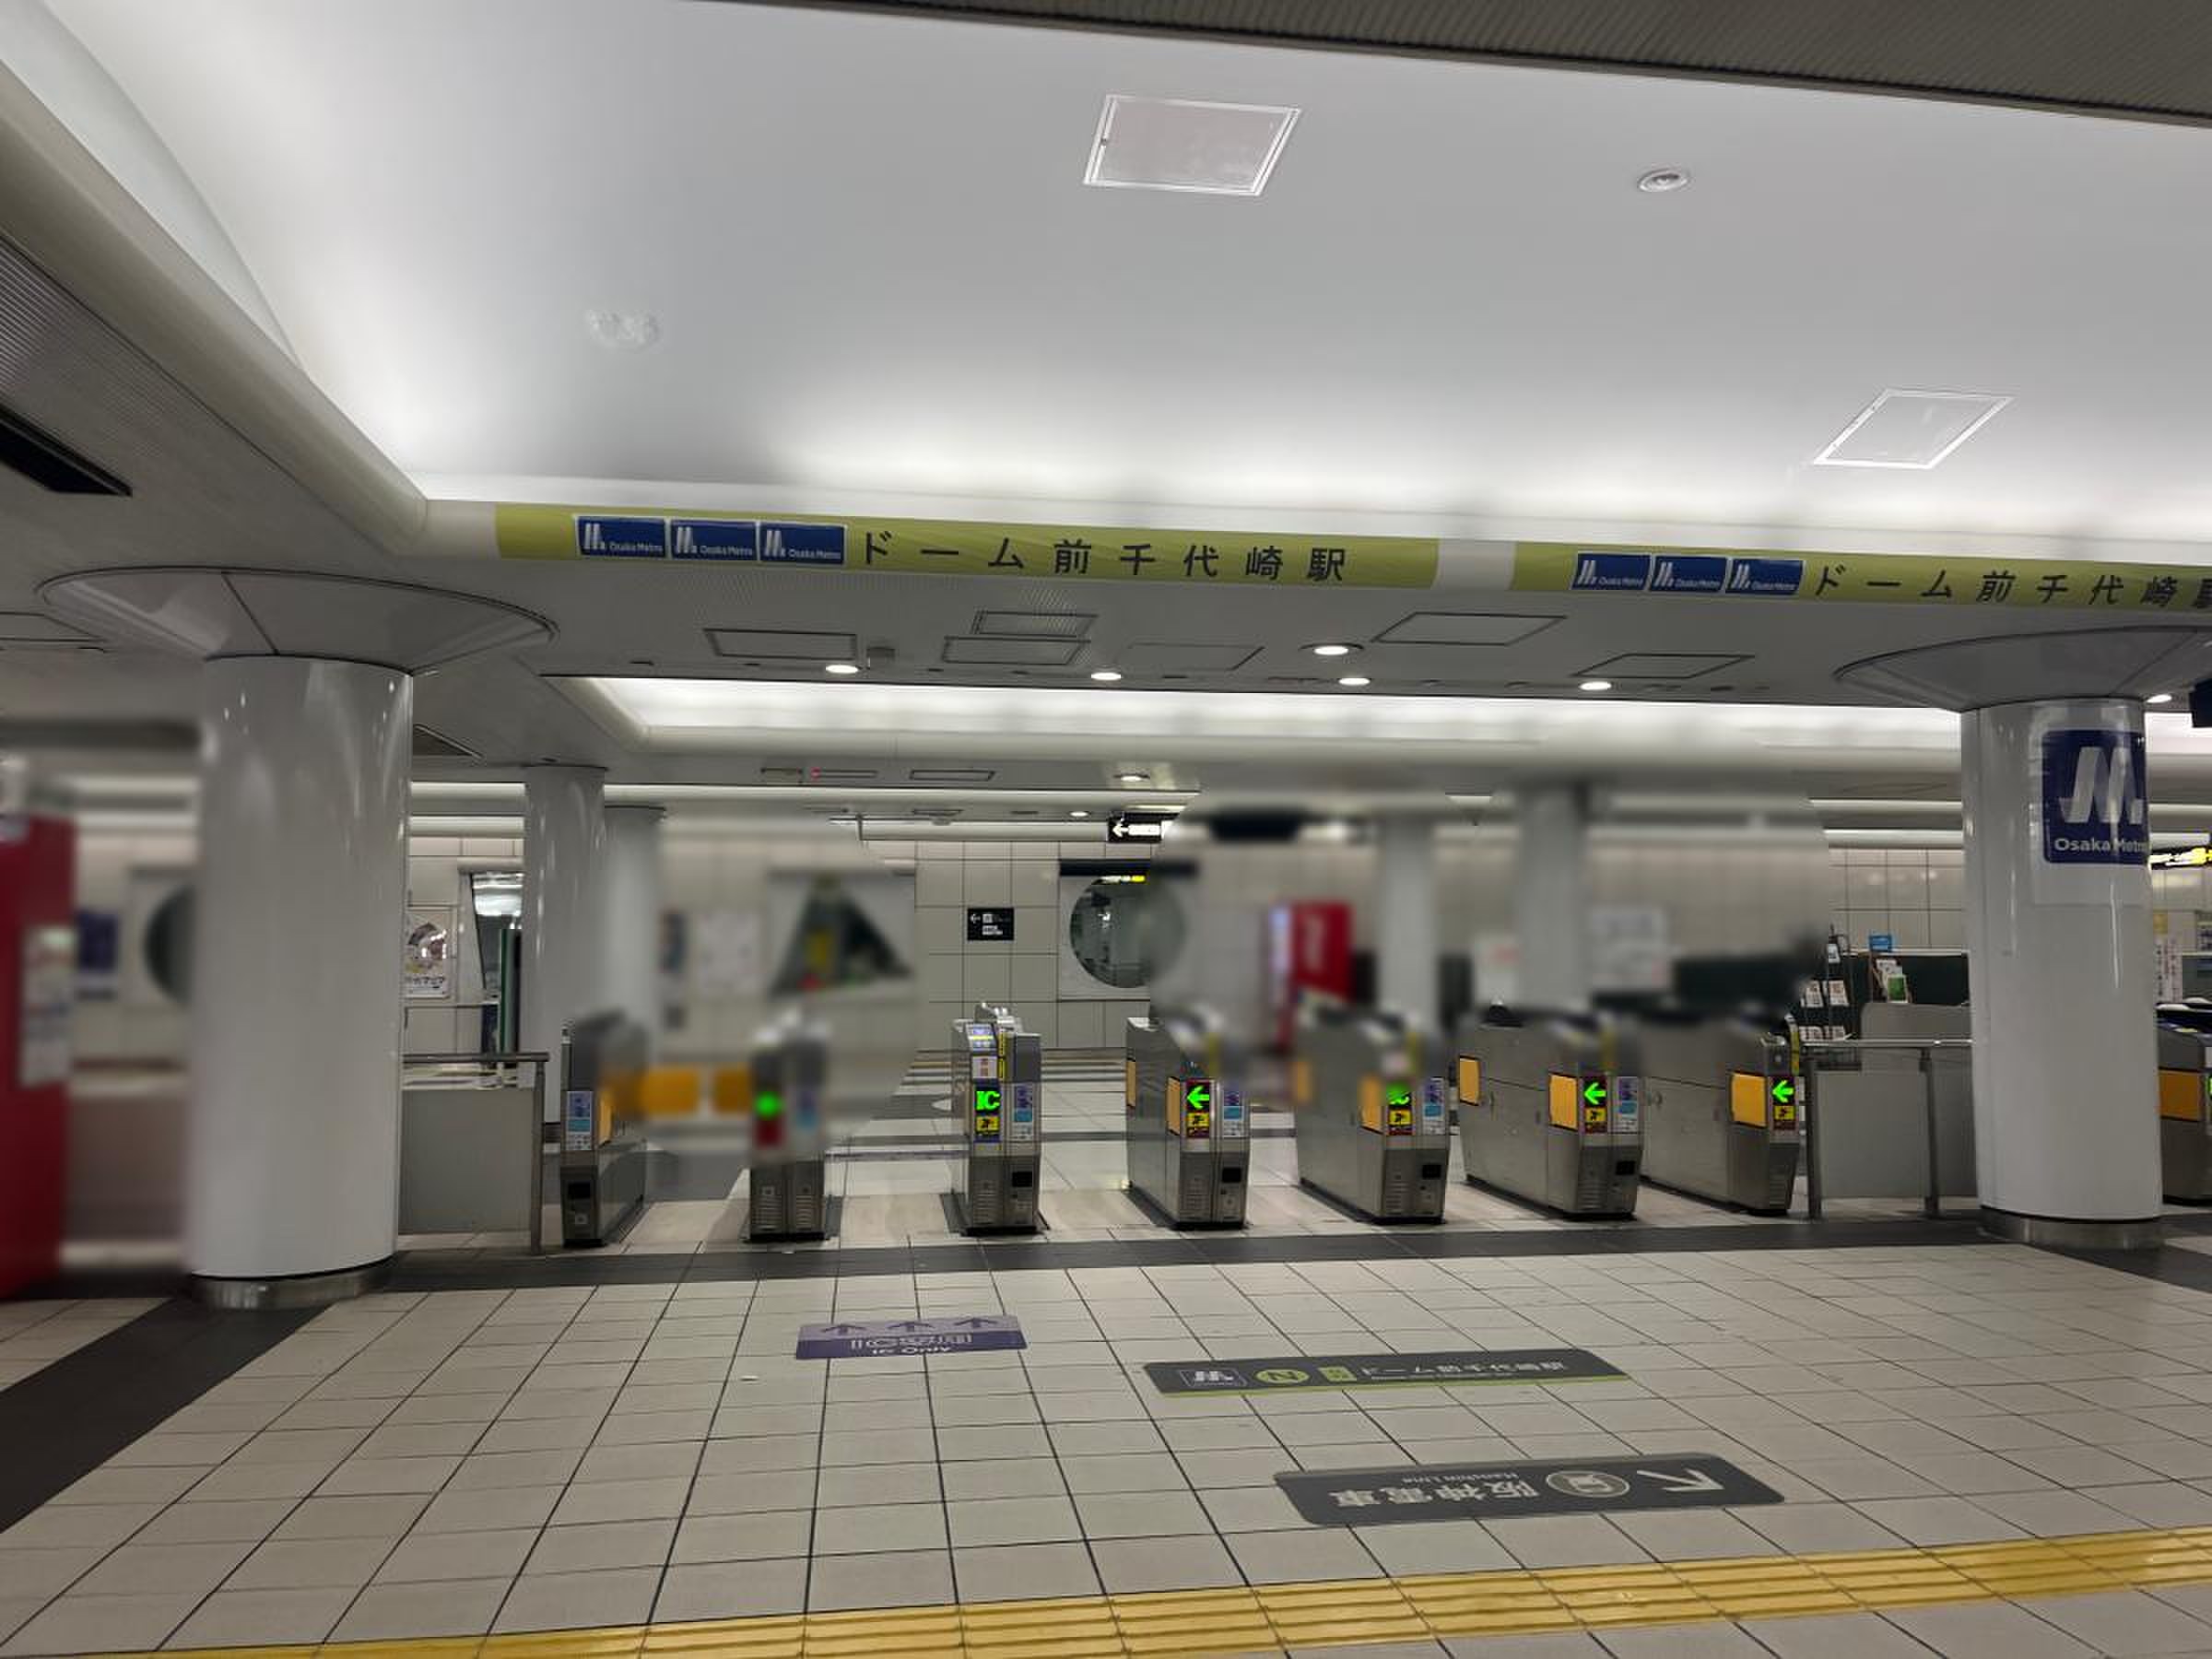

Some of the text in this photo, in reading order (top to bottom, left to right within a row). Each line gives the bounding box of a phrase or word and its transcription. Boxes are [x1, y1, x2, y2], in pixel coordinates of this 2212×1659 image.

[864, 531, 1346, 582] ドーム前千代崎駅
[2054, 835, 2112, 852] Osaka
[976, 1090, 1001, 1111] IC
